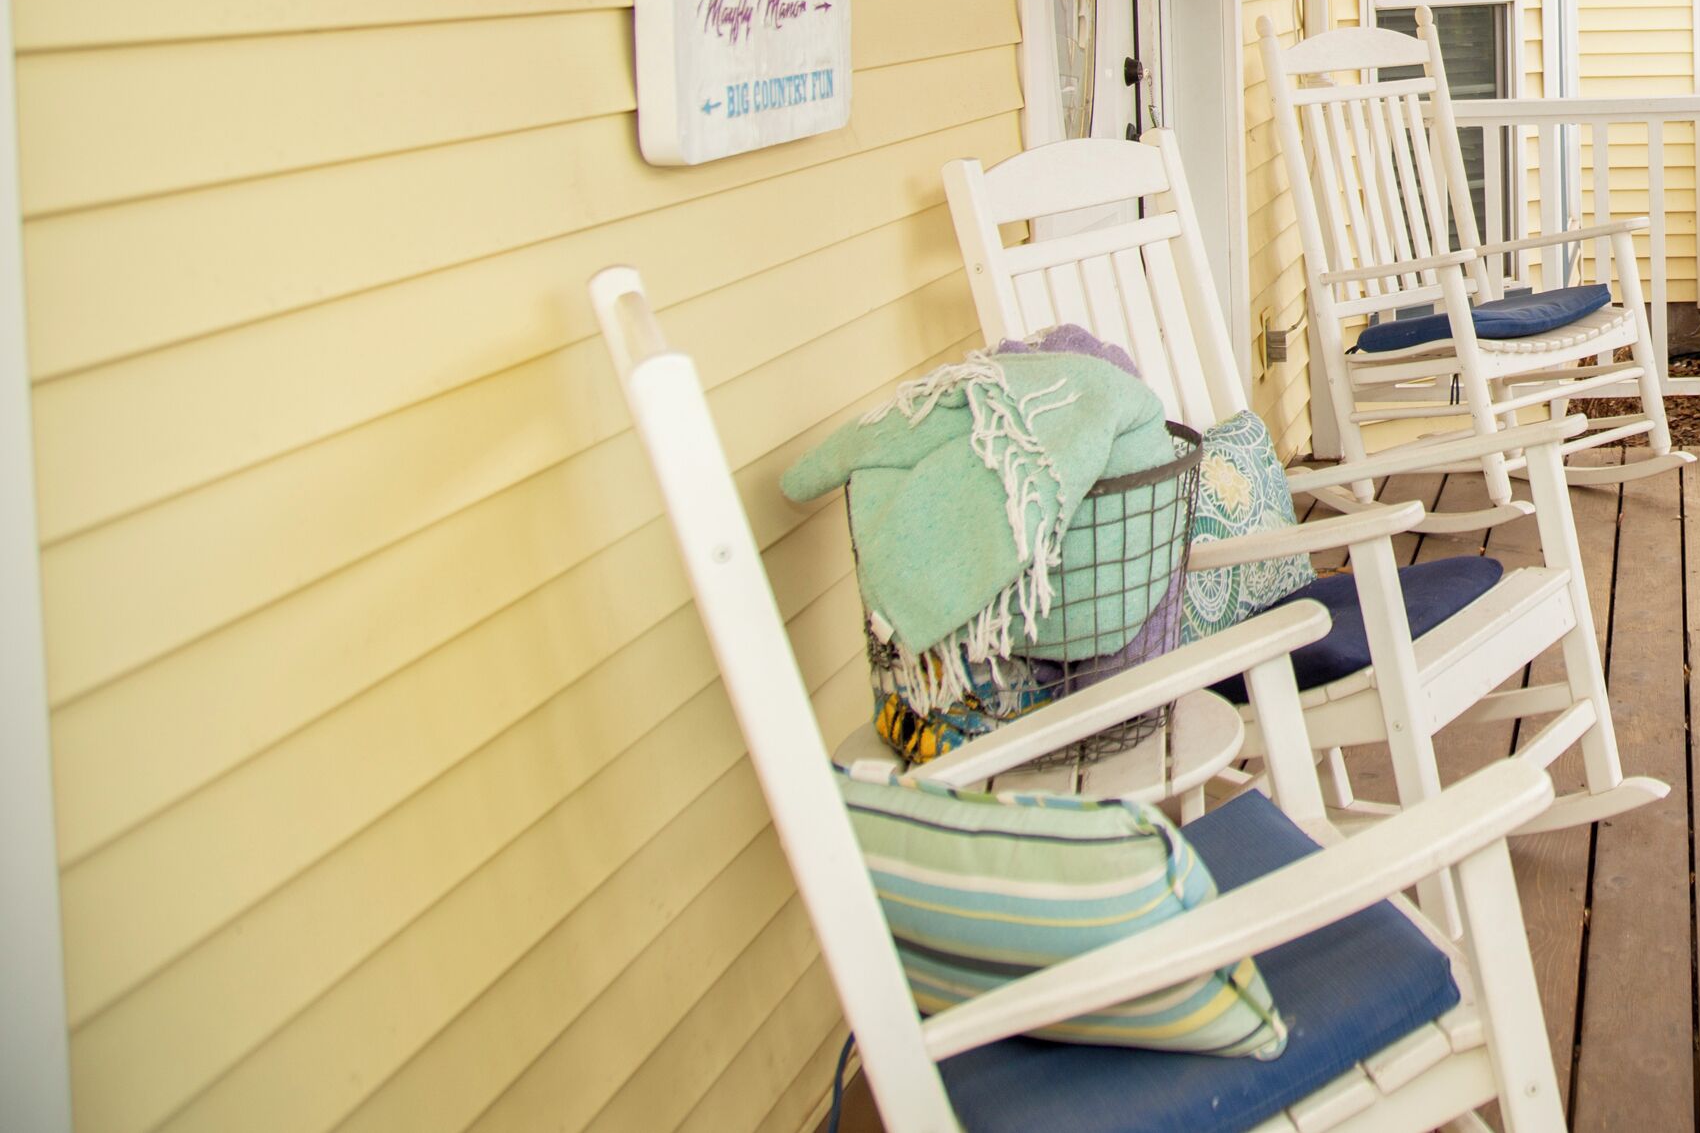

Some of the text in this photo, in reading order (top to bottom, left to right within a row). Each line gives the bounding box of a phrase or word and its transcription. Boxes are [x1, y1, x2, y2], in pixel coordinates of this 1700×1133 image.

[726, 68, 835, 118] BIG COUNTRY FUN
